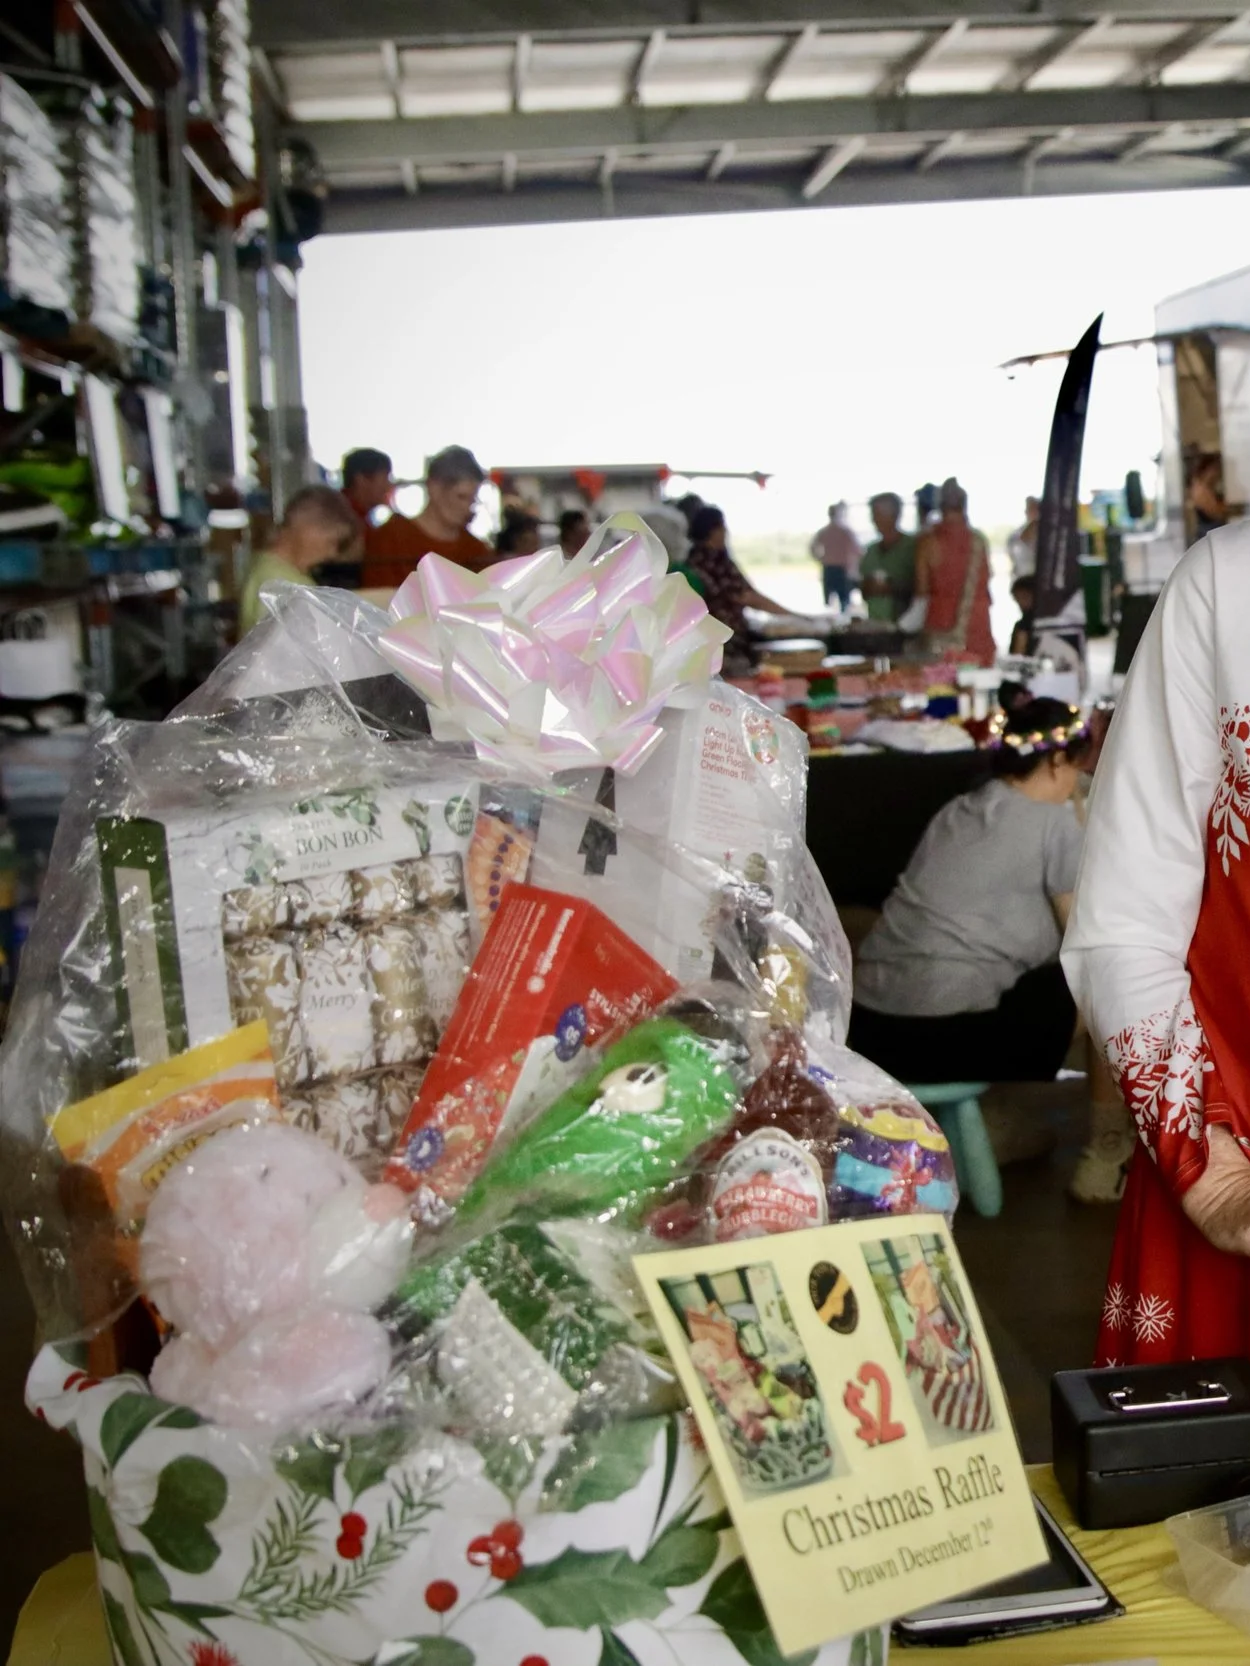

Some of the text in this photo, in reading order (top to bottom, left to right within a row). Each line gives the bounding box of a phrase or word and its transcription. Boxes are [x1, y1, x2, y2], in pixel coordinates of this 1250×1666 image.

[700, 759, 739, 780] Christmas
[701, 748, 726, 765] Green
[296, 825, 384, 856] BON BON
[308, 992, 360, 1012] Merry
[842, 1360, 907, 1450] $2
[782, 1453, 1005, 1556] Christmas Raffle
[837, 1556, 900, 1595] Drawn
[898, 1528, 975, 1575] December
